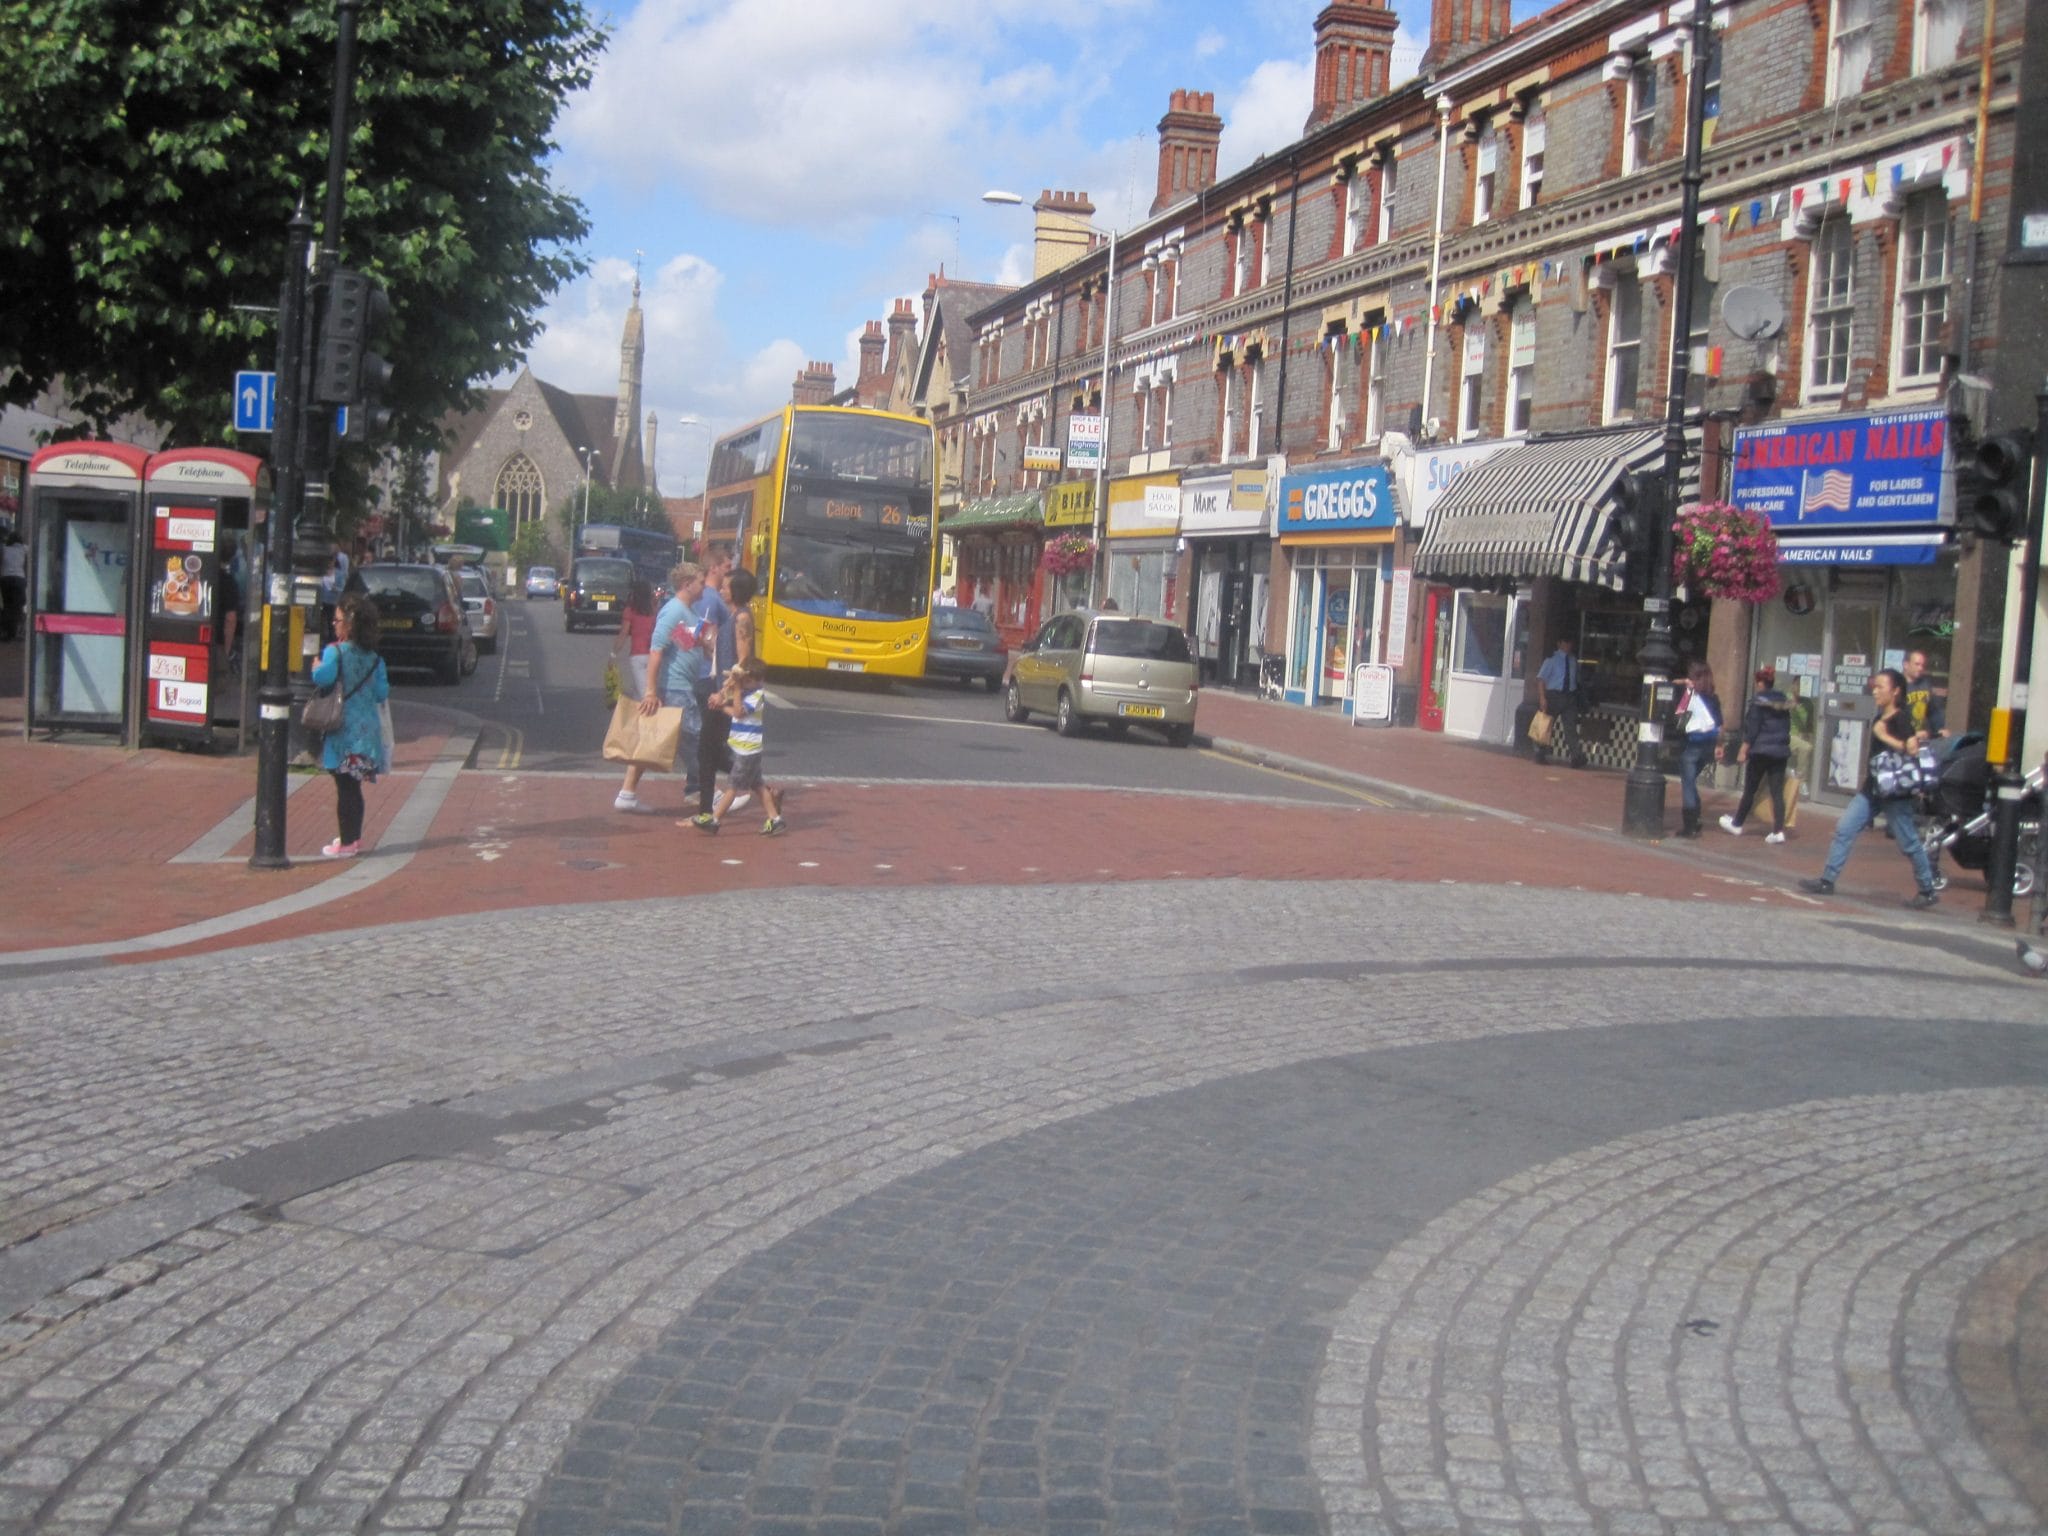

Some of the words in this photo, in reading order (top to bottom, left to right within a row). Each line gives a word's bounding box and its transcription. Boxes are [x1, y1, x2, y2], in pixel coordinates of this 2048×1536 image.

[1071, 423, 1086, 433] TO
[1087, 425, 1100, 434] LE
[1736, 428, 1857, 471] AMERICAN
[1864, 420, 1946, 461] NAILS
[64, 457, 111, 473] Telephone
[178, 464, 224, 479] Telephone
[1737, 485, 1794, 498] PROFESSIONAL
[1869, 480, 1888, 492] FOR
[1889, 478, 1923, 490] LADIES
[1152, 490, 1173, 501] HAIR
[1304, 478, 1378, 522] GREGGS
[1856, 496, 1877, 508] AND
[1877, 493, 1934, 507] GENTLEMEN
[1148, 502, 1177, 512] SALON
[1763, 501, 1785, 512] CARE
[881, 504, 901, 525] 26
[1783, 549, 1836, 561] AMERICAN
[1840, 549, 1873, 560] NAILS
[822, 620, 857, 636] Reading
